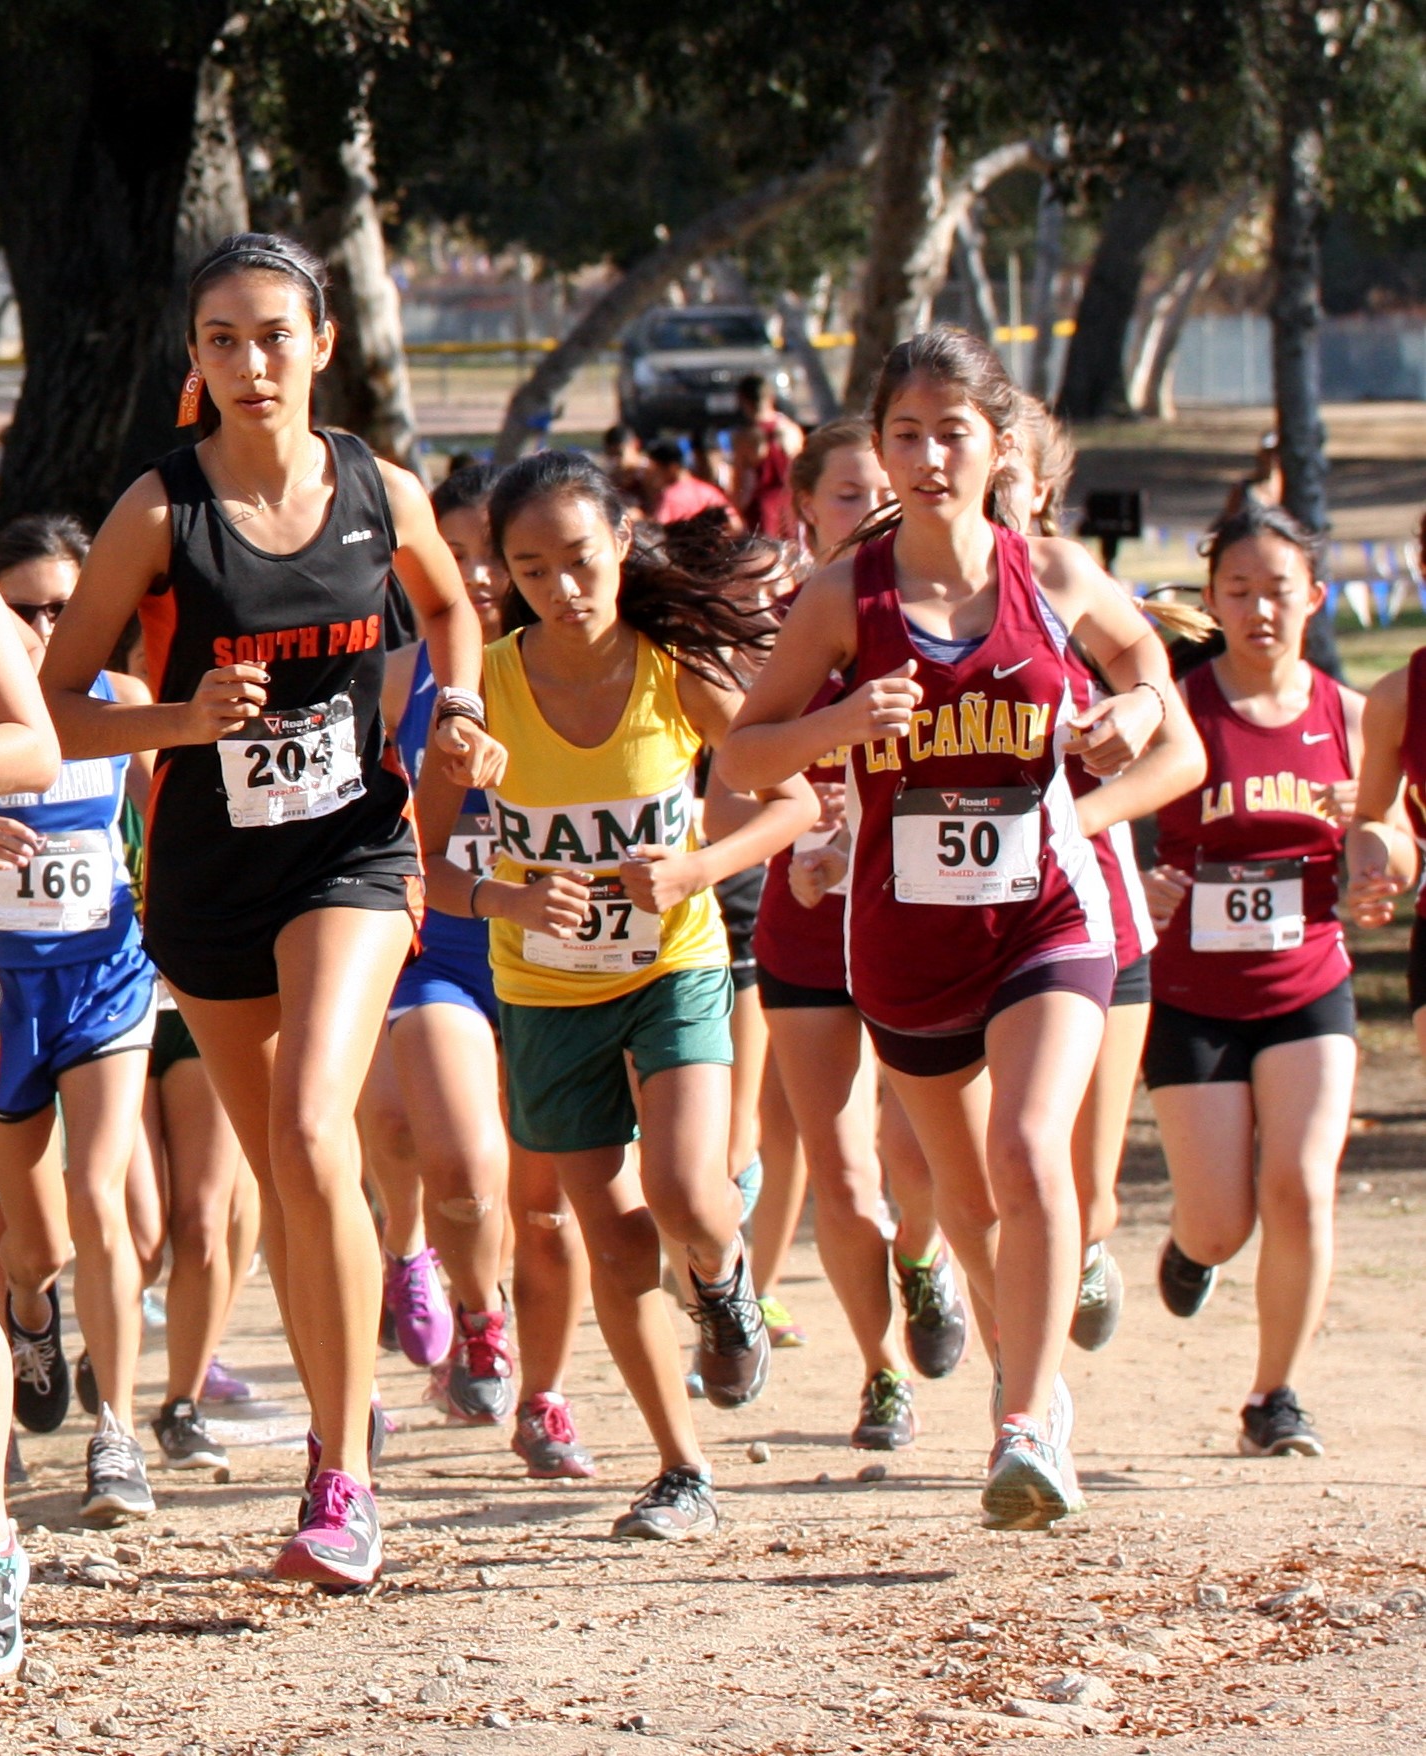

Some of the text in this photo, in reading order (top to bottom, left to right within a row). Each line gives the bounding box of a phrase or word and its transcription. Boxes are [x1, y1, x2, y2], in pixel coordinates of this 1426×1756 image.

[213, 614, 381, 667] SOUTH PAS
[1201, 781, 1234, 824] LA
[495, 788, 686, 863] RAMS
[937, 820, 1000, 868] 50
[17, 859, 91, 899] 166
[1226, 888, 1273, 922] 68
